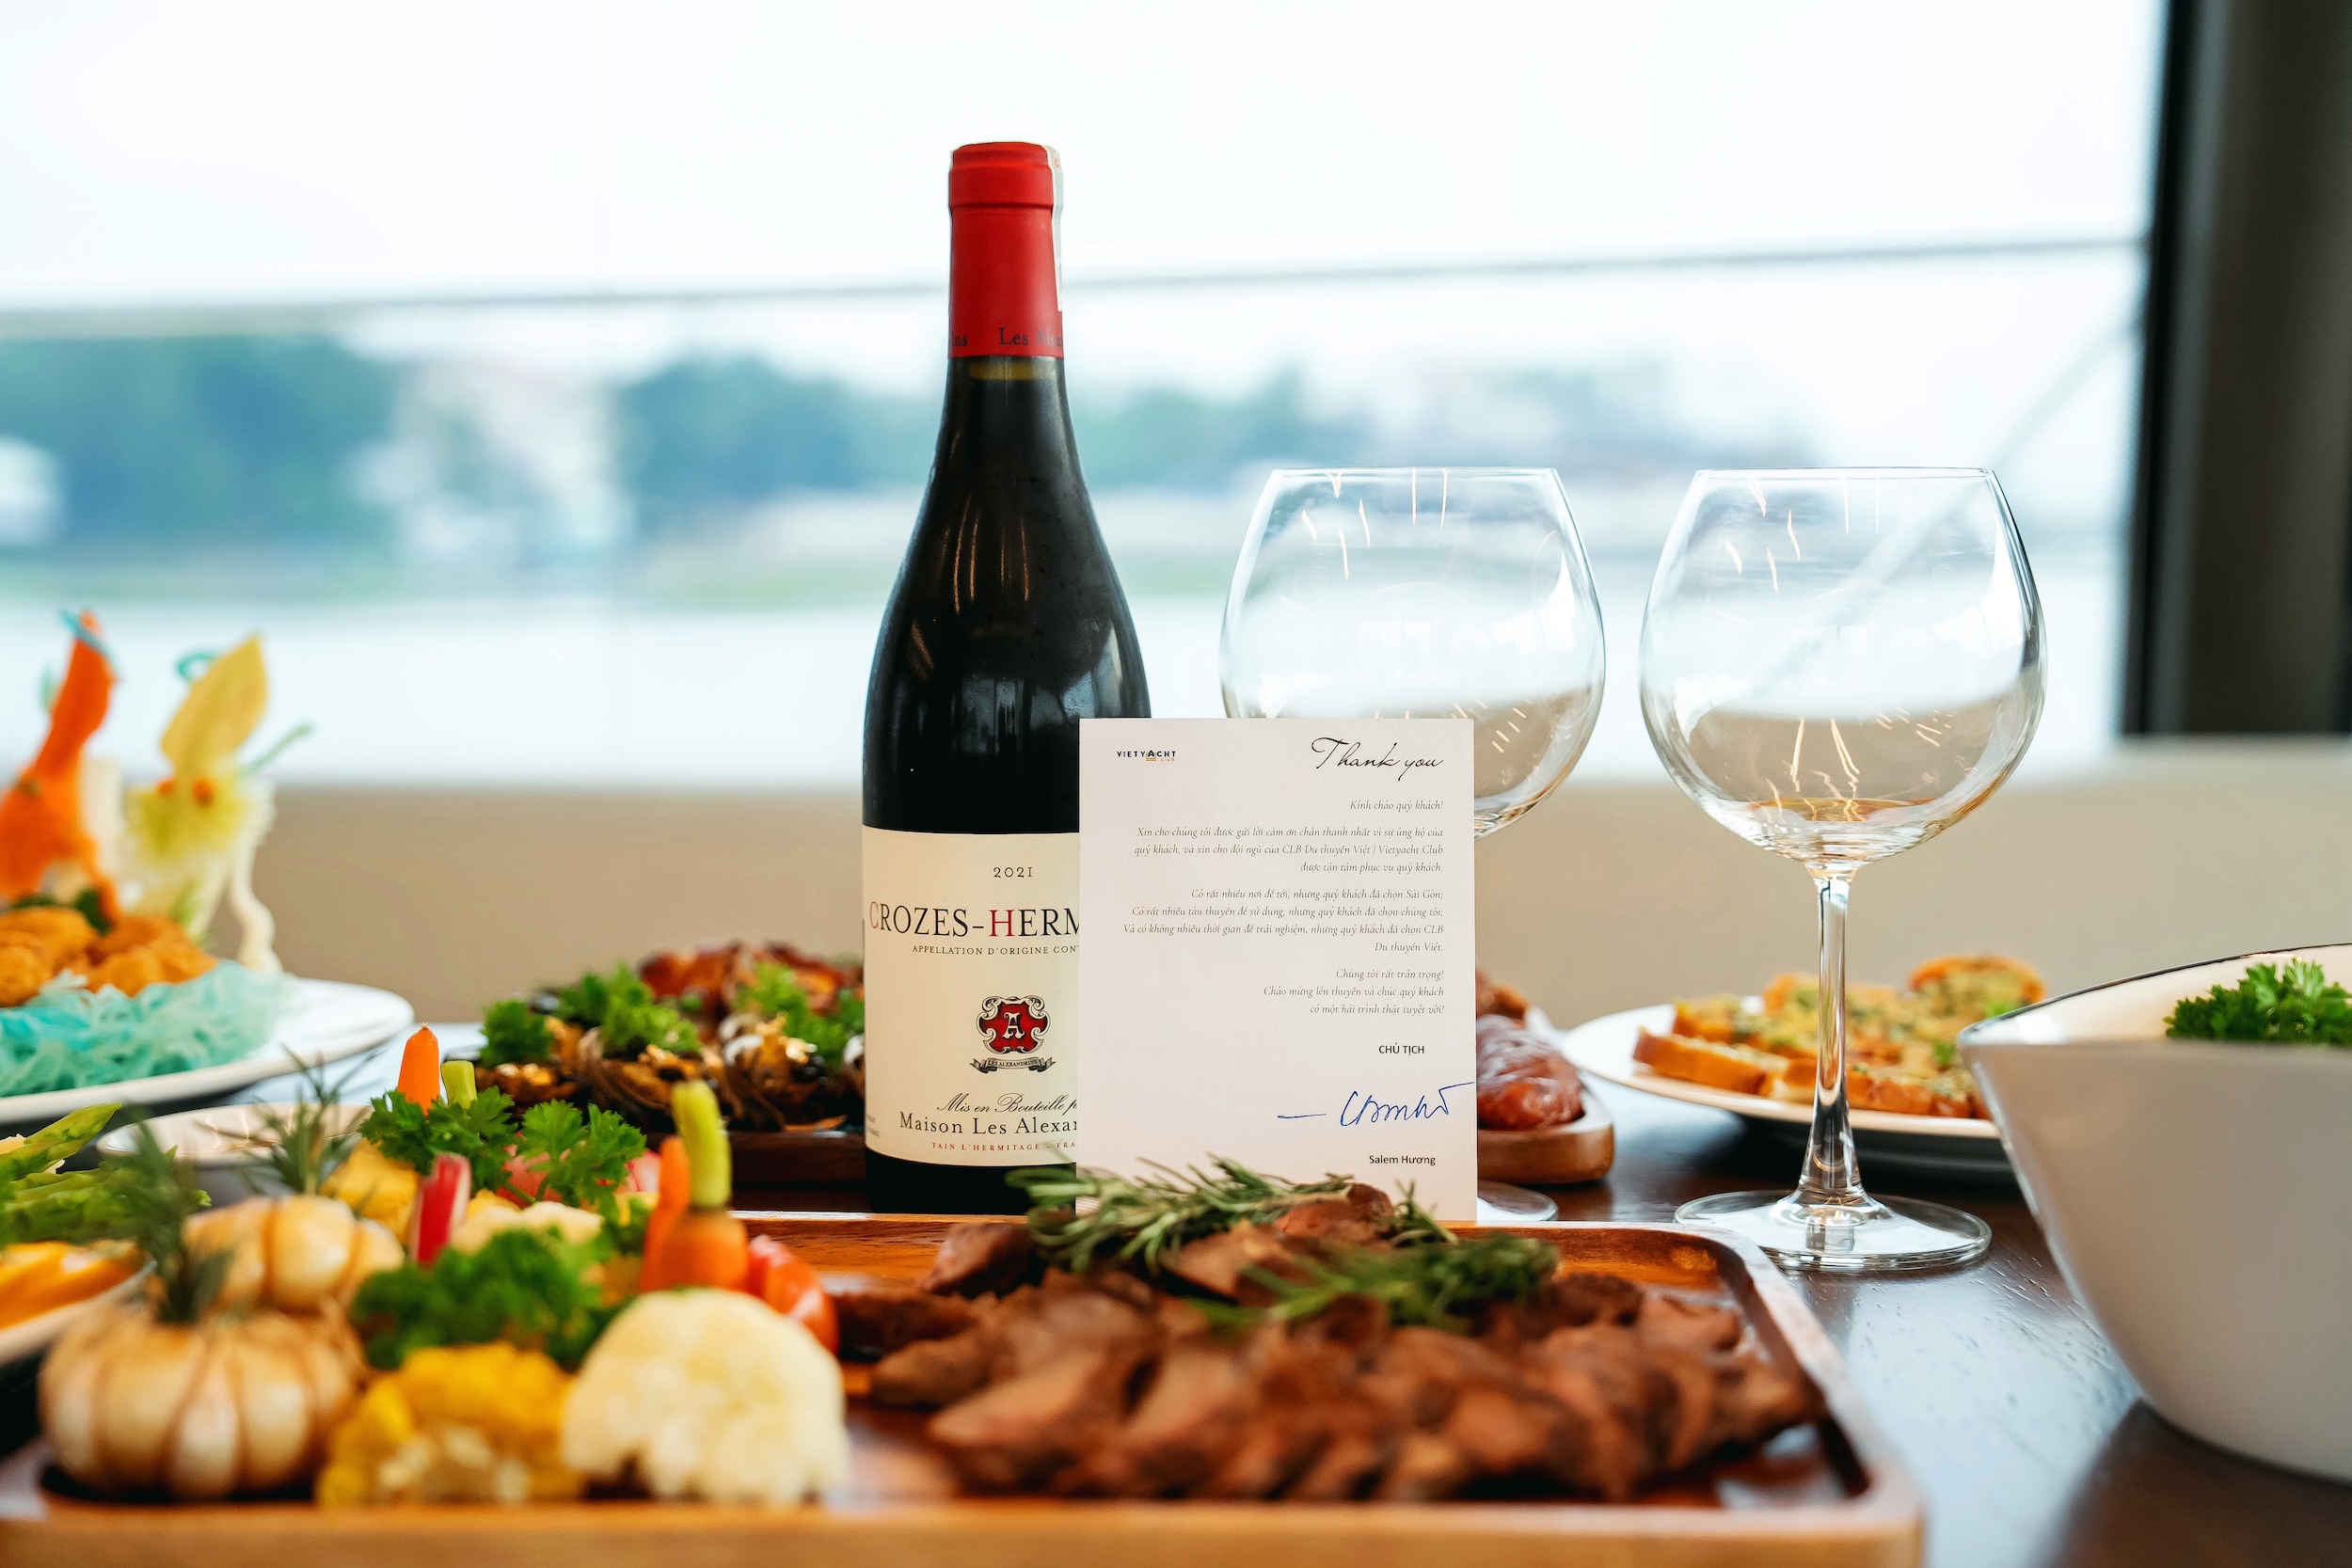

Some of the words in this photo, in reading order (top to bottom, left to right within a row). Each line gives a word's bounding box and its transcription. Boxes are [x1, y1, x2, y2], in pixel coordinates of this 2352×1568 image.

[999, 327, 1028, 345] Les
[1311, 736, 1401, 769] Thank
[1397, 758, 1444, 782] you
[1349, 799, 1372, 810] Kính
[1373, 799, 1394, 810] chào
[1395, 799, 1413, 814] quý
[1414, 799, 1444, 810] khách!
[1136, 827, 1152, 837] Xin
[1154, 826, 1169, 837] cho
[1169, 826, 1199, 840] chúng
[1200, 826, 1212, 836] tôi
[1213, 826, 1235, 839] được
[1235, 826, 1250, 840] gửi
[1252, 826, 1264, 837] lời
[1265, 826, 1284, 837] cảm
[1285, 828, 1297, 837] ơn
[1298, 826, 1320, 837] chân
[1322, 826, 1348, 837] thành
[1350, 826, 1372, 837] nhất
[1373, 826, 1382, 837] vì
[1383, 829, 1395, 839] sự
[1396, 827, 1413, 840] ủng
[1414, 826, 1426, 839] hộ
[1427, 827, 1443, 837] của
[1134, 843, 1152, 858] quý
[1152, 843, 1181, 855] khách,
[1184, 843, 1195, 854] và
[1196, 845, 1211, 854] xin
[1212, 843, 1229, 854] cho
[1230, 843, 1244, 856] đội
[1263, 844, 1280, 854] của
[1281, 844, 1302, 854] CLB
[1304, 844, 1318, 854] Du
[1353, 844, 1371, 857] Việt
[1378, 844, 1420, 858] Vietyacht
[1422, 844, 1444, 855] Club
[993, 866, 1033, 879] 2021
[1300, 861, 1322, 874] được
[1323, 861, 1338, 874] tận
[1340, 861, 1358, 872] tâm
[1359, 861, 1381, 875] phục
[1383, 864, 1394, 874] vụ
[1396, 861, 1413, 875] quý
[1415, 861, 1443, 872] khách.
[1191, 887, 1204, 898] Có
[1248, 889, 1263, 898] nơi
[1276, 888, 1291, 900] tới,
[1293, 888, 1321, 902] nhưng
[1322, 888, 1340, 902] quý
[1341, 888, 1367, 899] khách
[1369, 888, 1380, 899] đã
[1382, 888, 1404, 901] chọn
[1405, 888, 1421, 899] Sài
[1422, 888, 1443, 900] Gòn;
[869, 900, 1079, 938] CROZES-HERM
[1132, 905, 1145, 916] Có
[1187, 905, 1203, 916] tàu
[1249, 906, 1261, 916] sử
[1262, 905, 1286, 920] dụng,
[1288, 905, 1316, 920] nhưng
[1317, 905, 1335, 920] quý
[1336, 906, 1362, 916] khách
[1364, 906, 1376, 916] đã
[1377, 906, 1399, 919] chọn
[1400, 906, 1427, 920] chúng
[1429, 906, 1443, 918] tôi;
[1123, 923, 1136, 934] Và
[1136, 923, 1147, 934] có
[1149, 923, 1175, 937] không
[1221, 924, 1242, 937] gian
[1256, 923, 1273, 934] trải
[1275, 923, 1309, 937] nghiệm,
[1311, 923, 1339, 937] nhưng
[1340, 923, 1358, 938] quý
[1359, 923, 1385, 934] khách
[1387, 923, 1399, 934] đã
[1400, 923, 1422, 936] chọn
[1423, 924, 1444, 934] CLB
[912, 944, 983, 955] APPELLATION
[987, 946, 1049, 956] D'ORIGINE
[1053, 944, 1079, 954] CON
[1375, 942, 1389, 952] Du
[1423, 941, 1443, 954] Việt.
[1336, 968, 1365, 982] Chúng
[1366, 968, 1379, 978] tôi
[1396, 968, 1416, 979] trân
[1418, 969, 1445, 982] trọng!
[1263, 985, 1287, 996] Chào
[1289, 985, 1314, 1000] mừng
[1315, 985, 1329, 996] lên
[1363, 985, 1375, 996] và
[1376, 985, 1398, 996] chúc
[1399, 985, 1417, 1000] quý
[1418, 985, 1444, 997] khách
[1310, 1003, 1320, 1014] có
[1322, 1003, 1339, 1016] một
[1341, 1003, 1356, 1014] hải
[1357, 1003, 1380, 1014] trình
[1382, 1003, 1401, 1016] thật
[1403, 1003, 1425, 1018] tuyệt
[1428, 1003, 1445, 1014] vời!
[1001, 1011, 1025, 1039] A
[1378, 1041, 1401, 1055] CHỦ
[1401, 1045, 1425, 1056] TỊCH
[937, 1092, 971, 1112] Mis
[994, 1092, 1069, 1113] Bouteille
[899, 1111, 963, 1134] Maison
[972, 1117, 1008, 1134] Les
[931, 1142, 956, 1150] TAIN
[961, 1143, 1041, 1151] L'HERMITAGE
[1368, 1154, 1400, 1164] Salem
[1401, 1154, 1437, 1167] Hương
